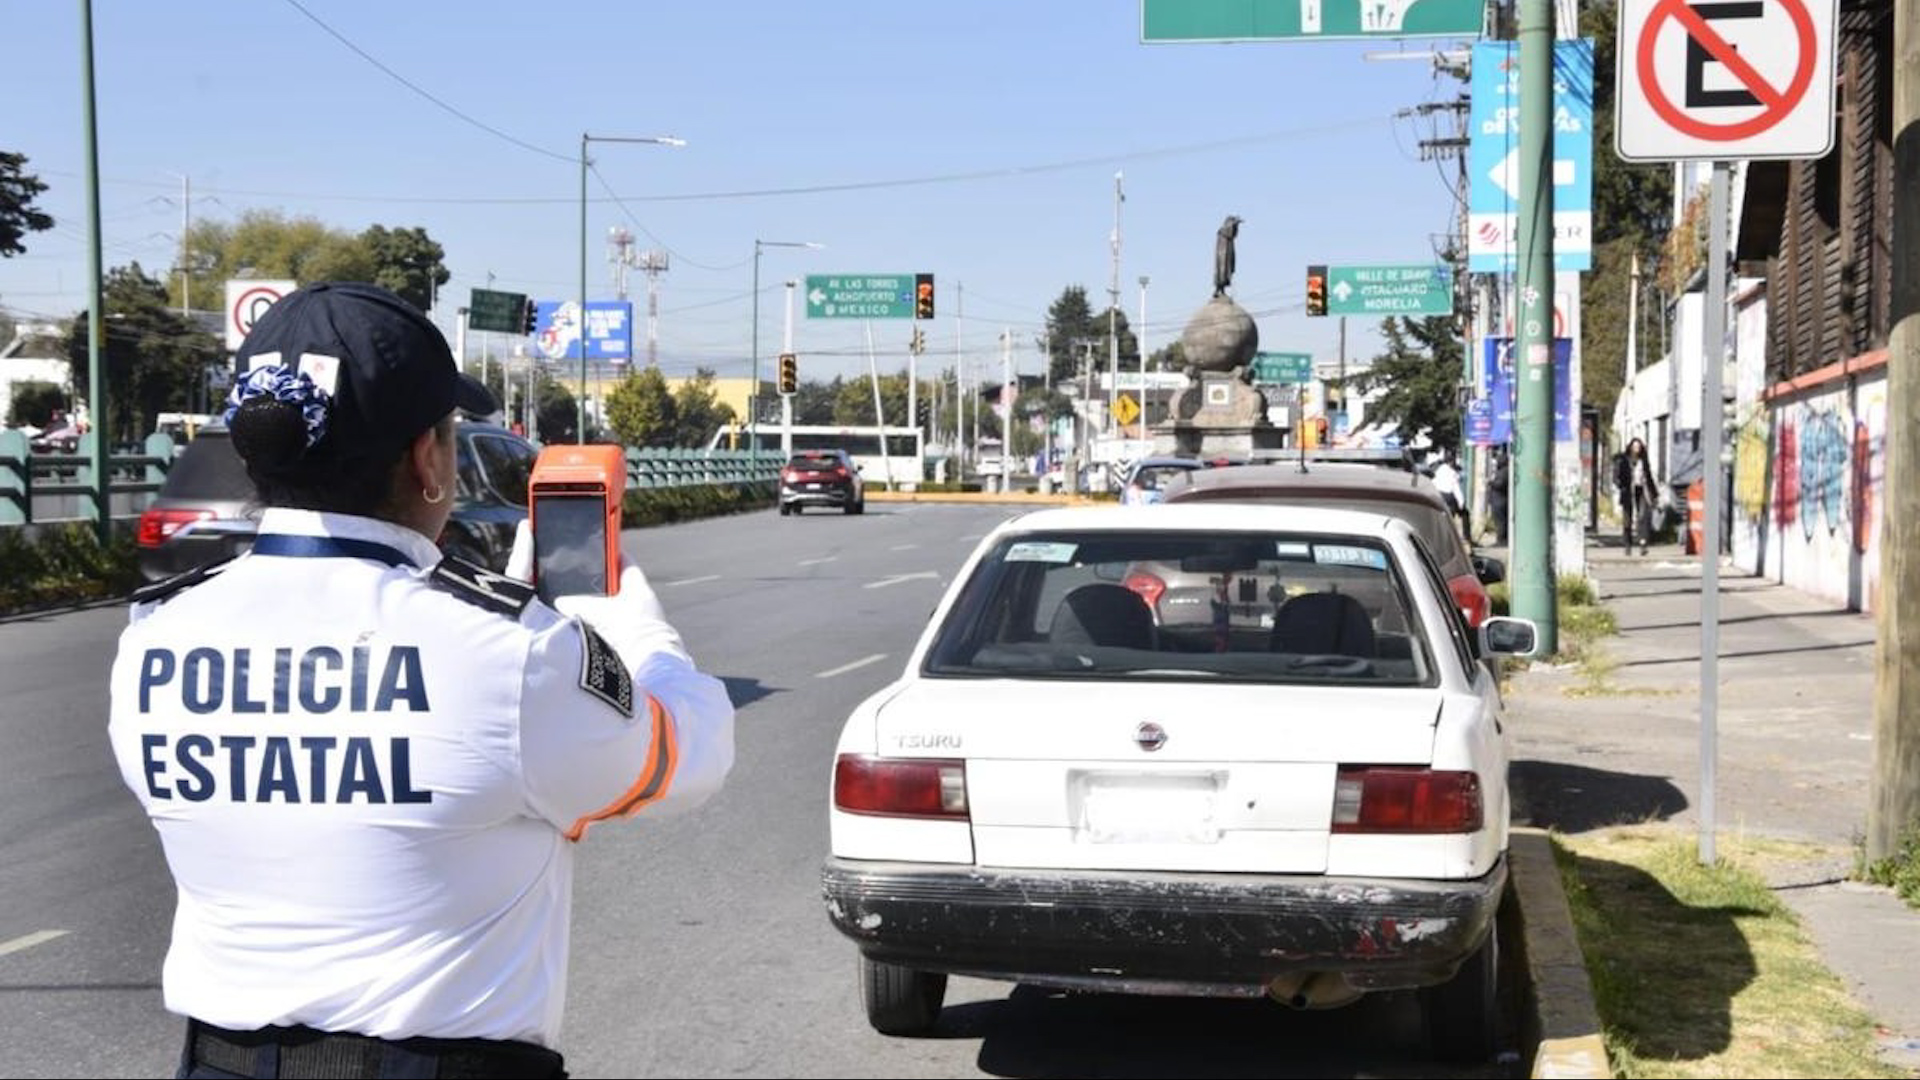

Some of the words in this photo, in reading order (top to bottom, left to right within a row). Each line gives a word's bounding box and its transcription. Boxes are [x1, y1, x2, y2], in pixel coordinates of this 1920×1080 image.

[1685, 1, 1764, 109] E
[845, 278, 862, 289] LAS
[866, 278, 899, 289] TORRES
[834, 291, 895, 302] AEROPUERTO
[1364, 298, 1421, 309] MORELIA
[891, 733, 963, 749] TSURU
[141, 733, 432, 804] ESTATAL
